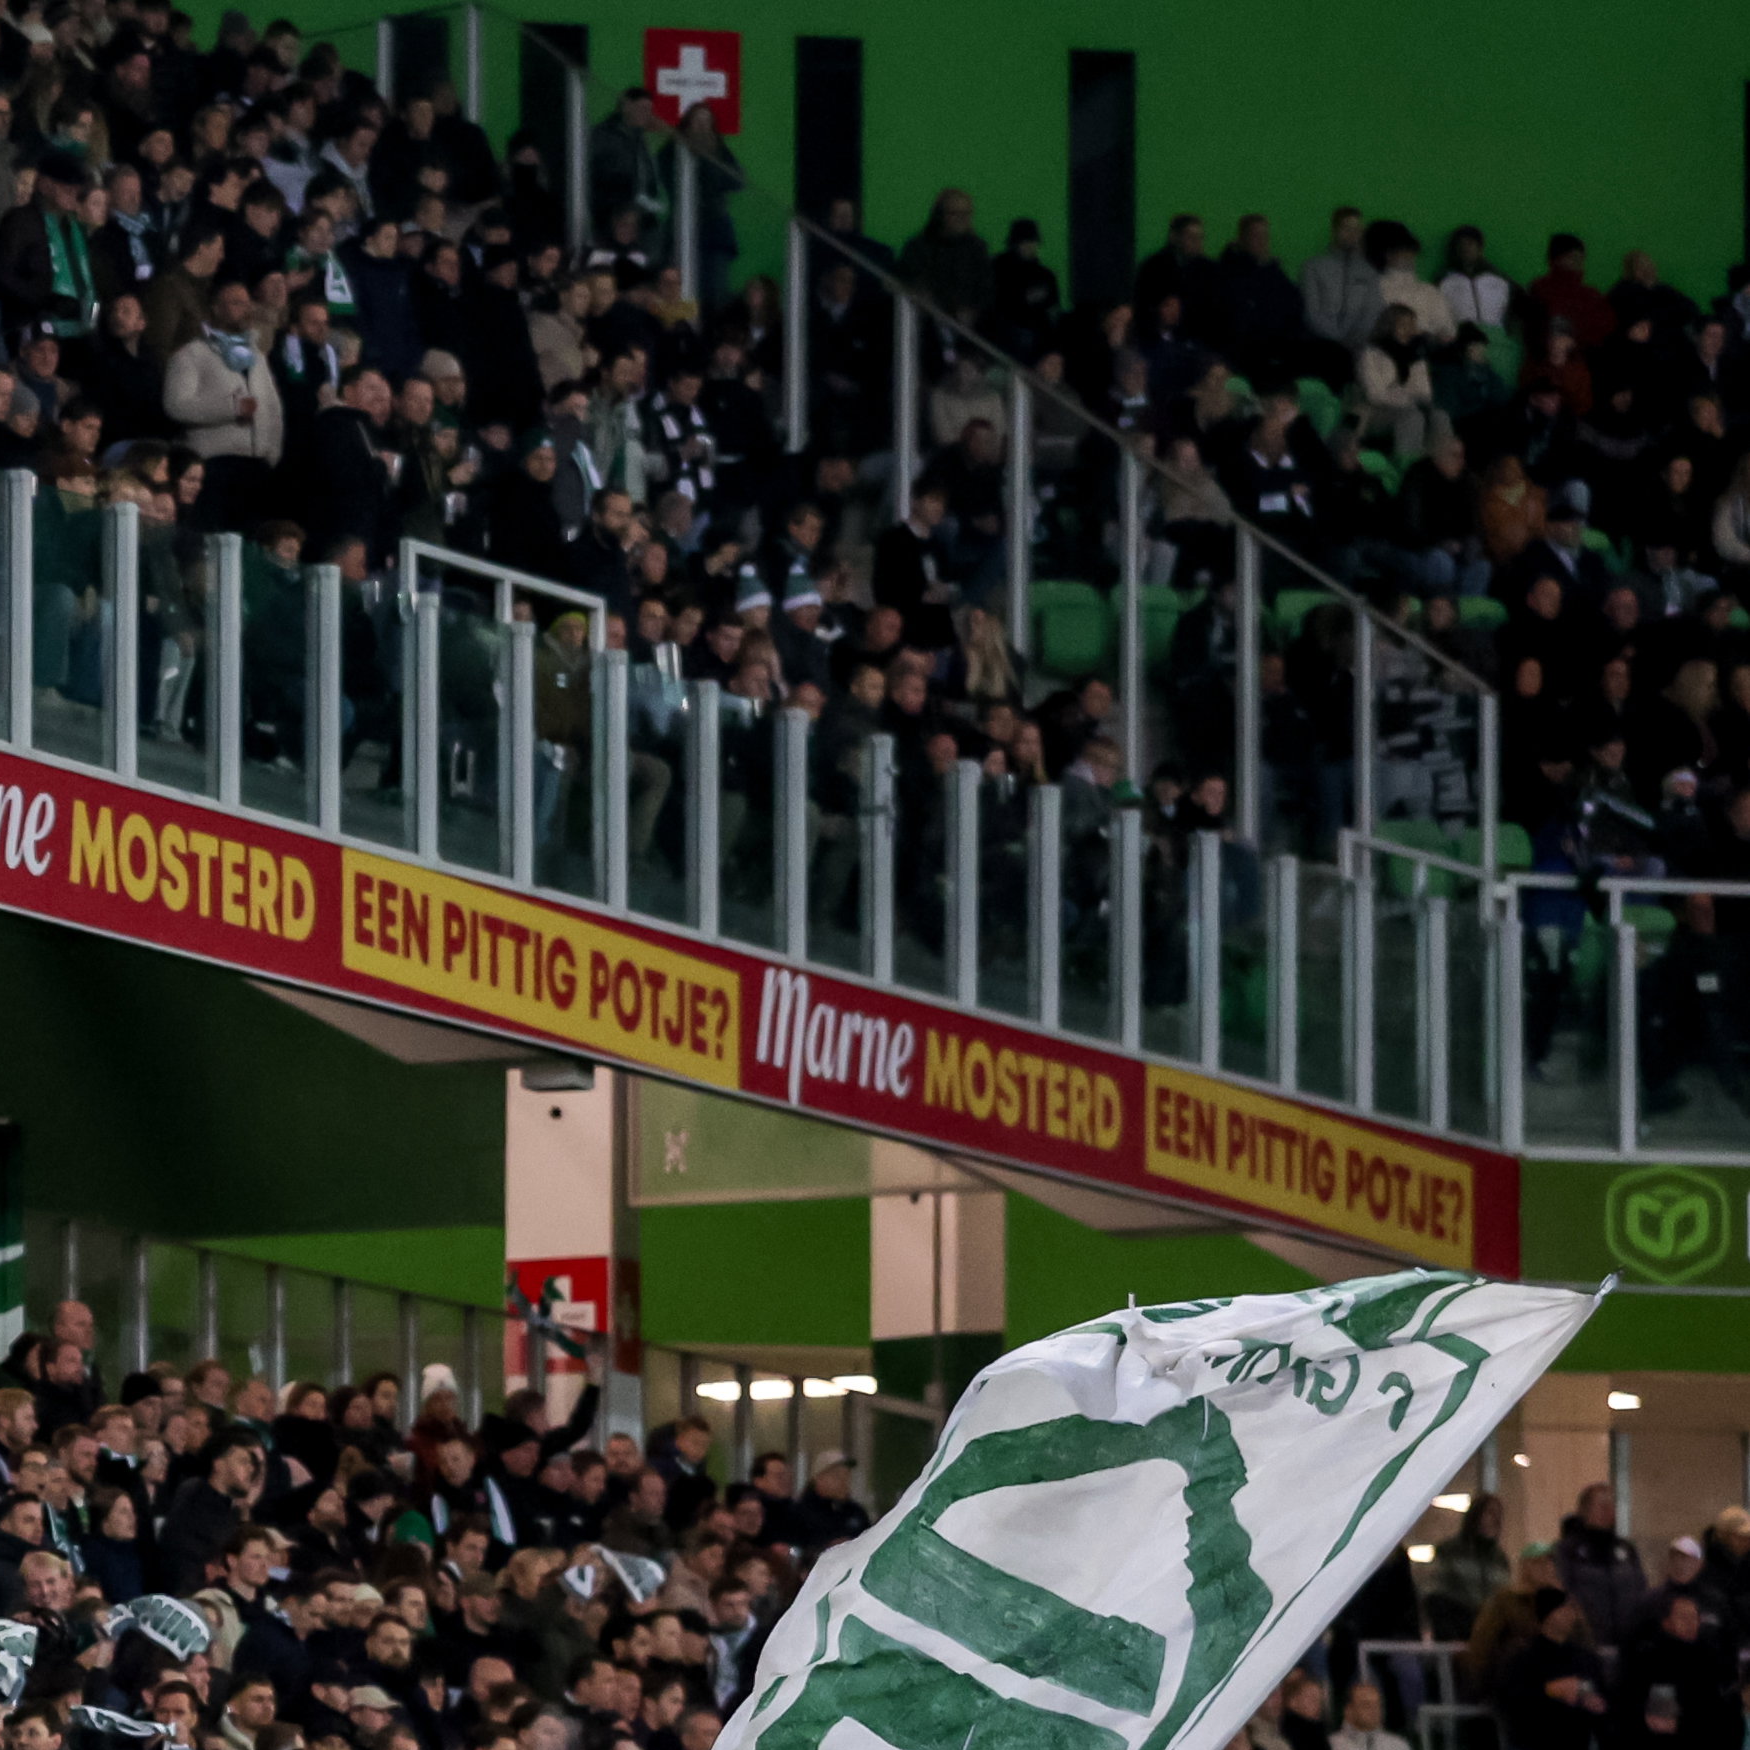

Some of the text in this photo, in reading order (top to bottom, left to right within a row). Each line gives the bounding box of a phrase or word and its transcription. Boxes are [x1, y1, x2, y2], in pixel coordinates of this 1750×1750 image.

[69, 800, 316, 942] MOSTERD
[352, 869, 731, 1061] EEN PITTIG POTJE?
[757, 966, 1122, 1153] Marne MOSTERD
[1153, 1086, 1465, 1246] EEN PITTIG POTJE?
